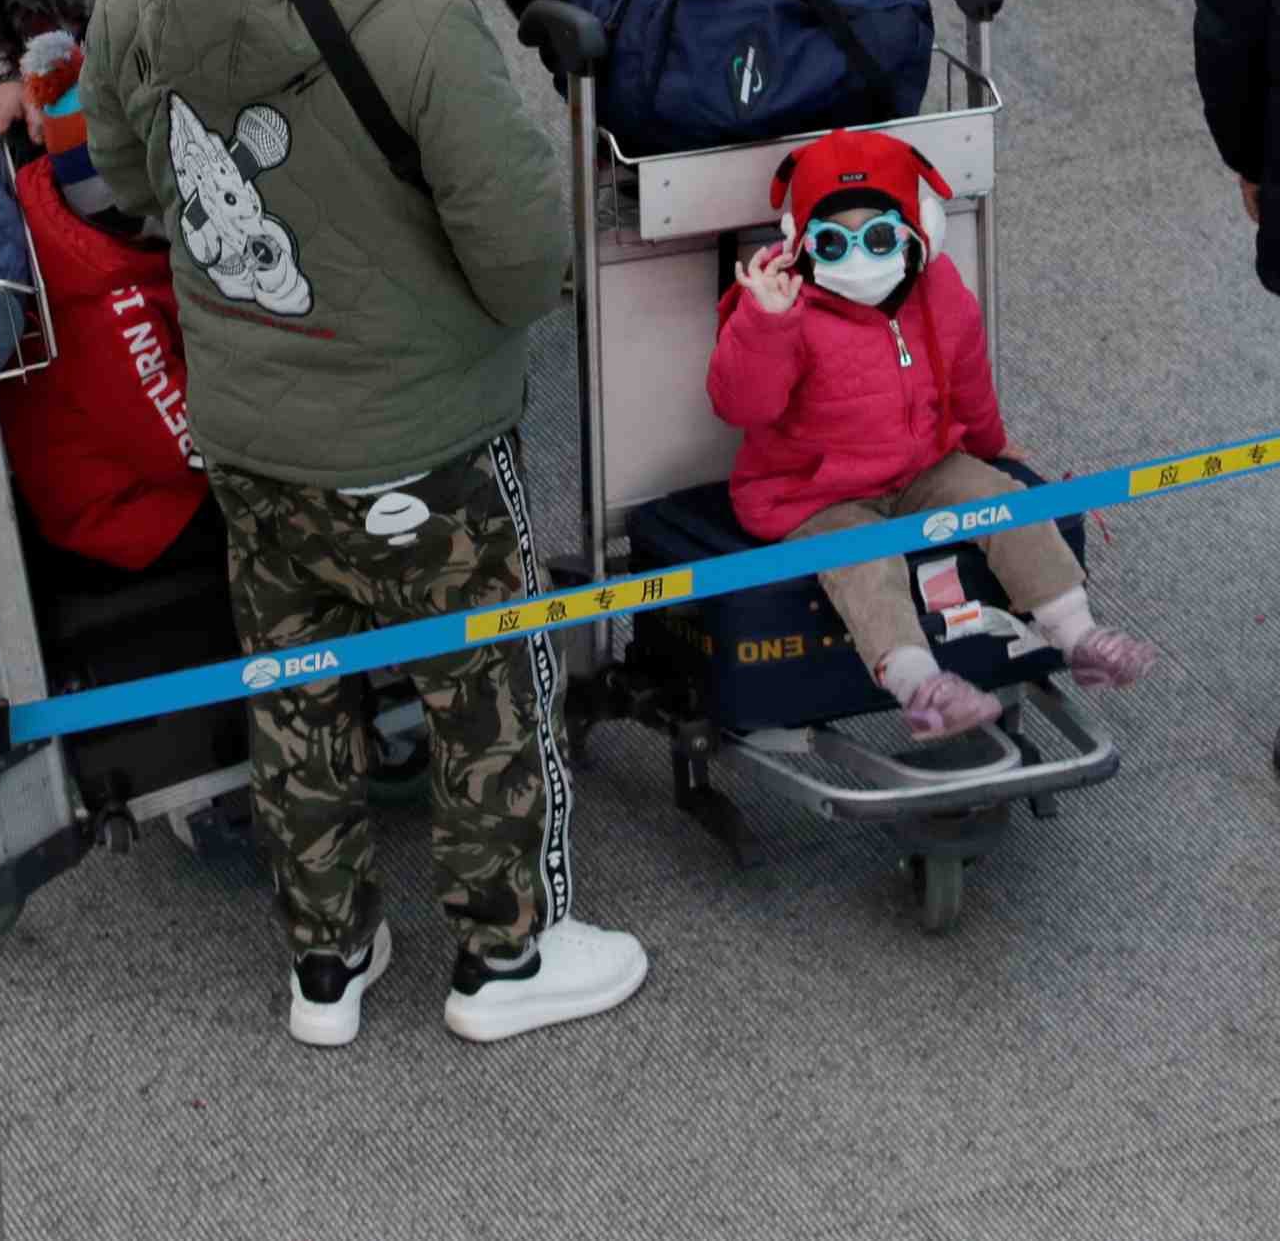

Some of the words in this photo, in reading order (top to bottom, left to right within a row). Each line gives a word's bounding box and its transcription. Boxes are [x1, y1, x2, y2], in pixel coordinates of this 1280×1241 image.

[961, 503, 1014, 531] BCIA
[496, 576, 664, 634] 应急专用
[284, 650, 339, 678] BCIA
